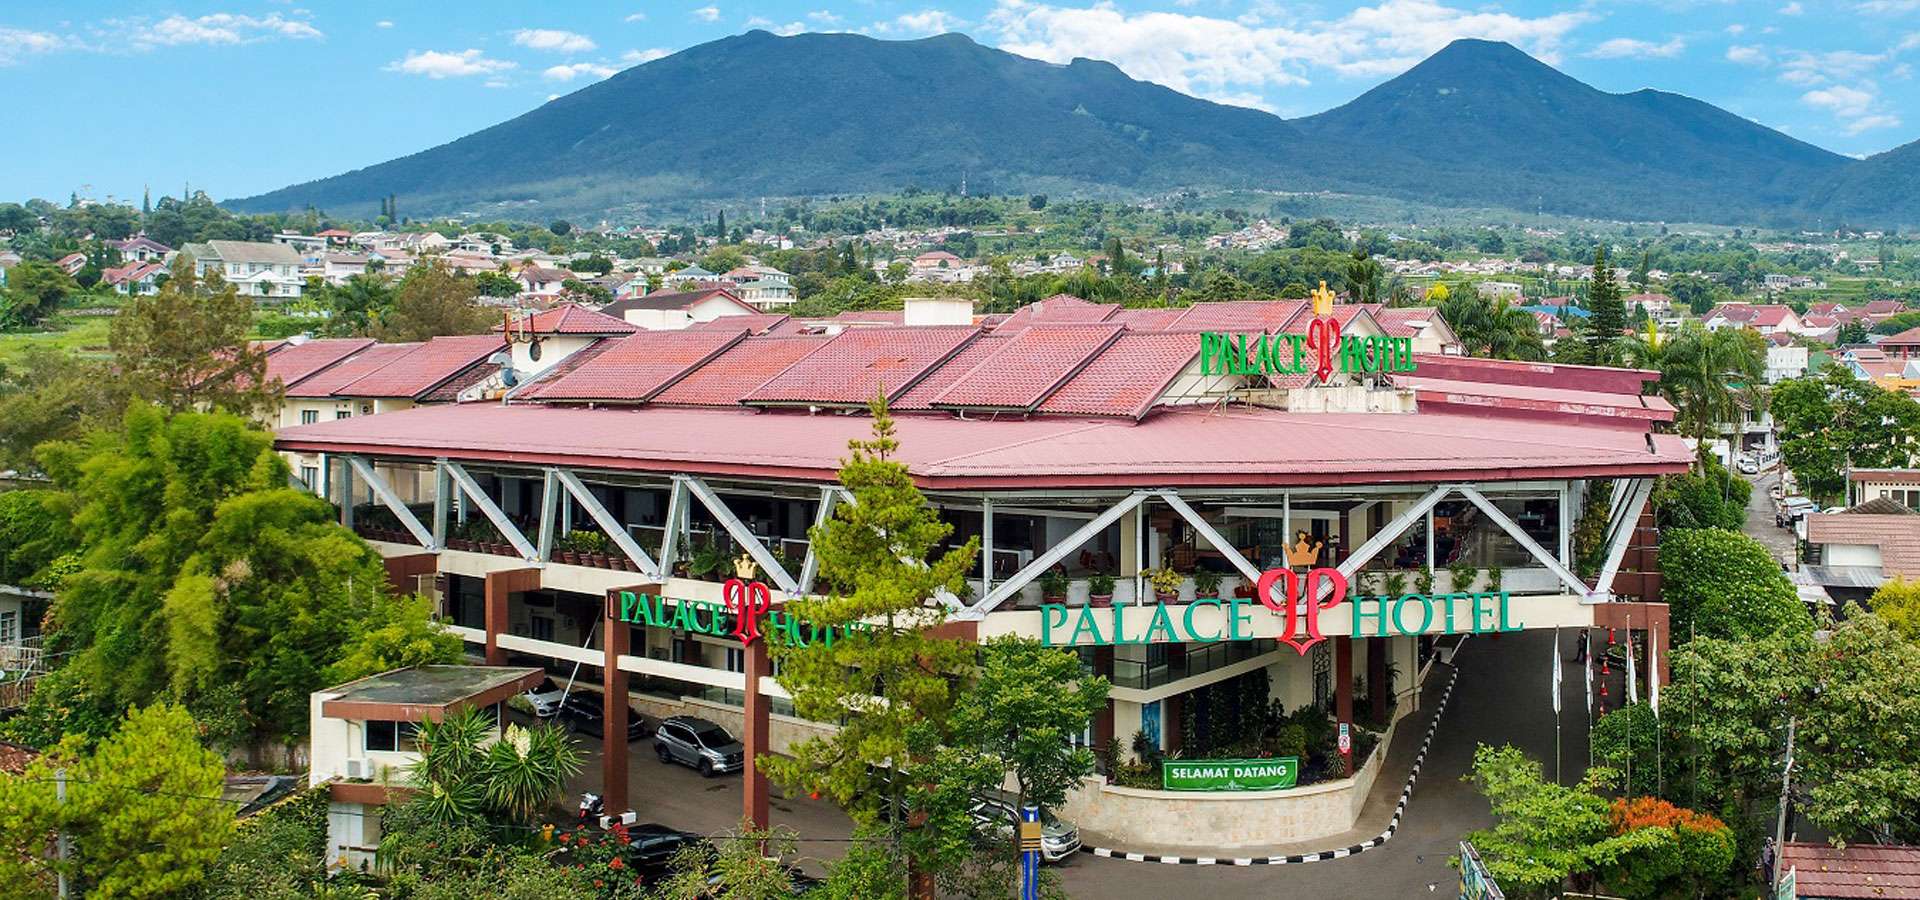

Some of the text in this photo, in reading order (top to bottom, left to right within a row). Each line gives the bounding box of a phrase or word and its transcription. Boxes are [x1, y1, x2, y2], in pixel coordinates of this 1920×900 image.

[1200, 331, 1307, 376] PALACE
[1340, 335, 1418, 374] HOTEL
[619, 591, 729, 636] PALACE
[1040, 597, 1254, 647] PALACE
[1350, 591, 1524, 640] HOTEL
[1171, 765, 1287, 779] SELAMAT DATANG
